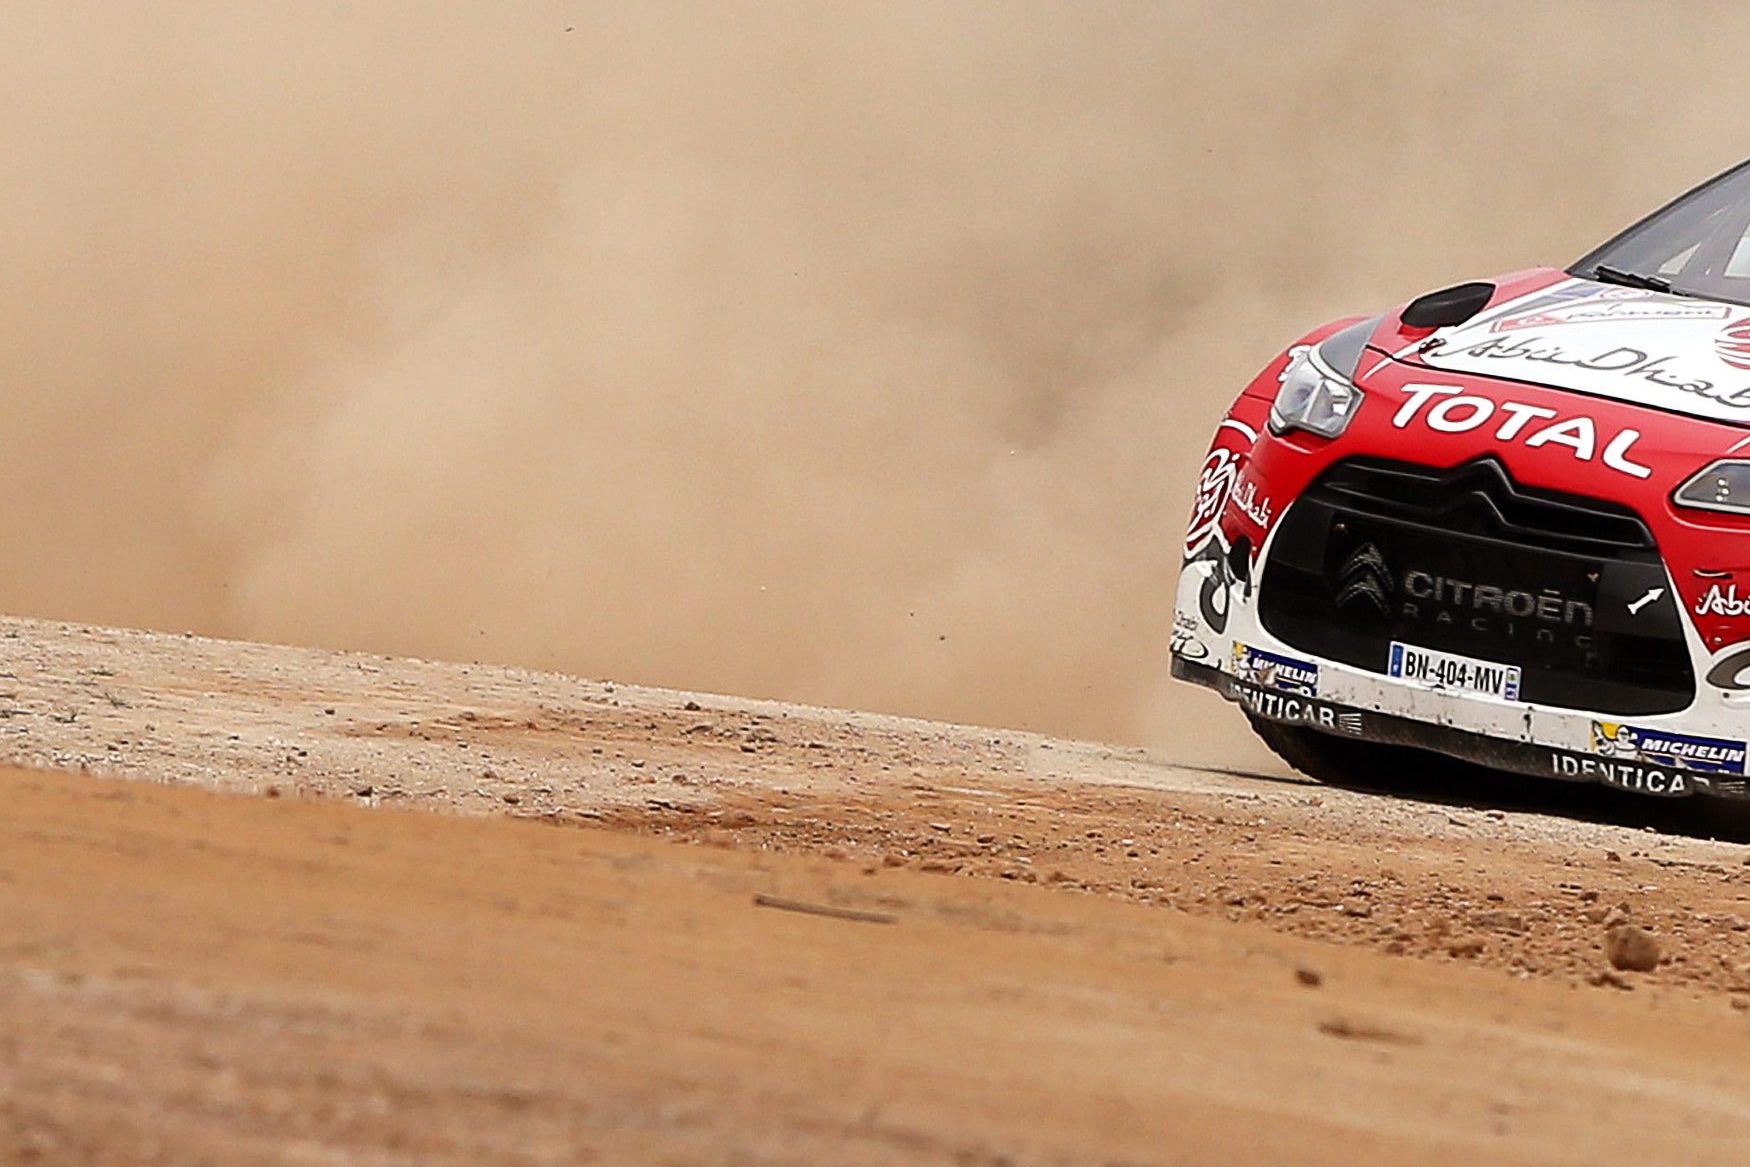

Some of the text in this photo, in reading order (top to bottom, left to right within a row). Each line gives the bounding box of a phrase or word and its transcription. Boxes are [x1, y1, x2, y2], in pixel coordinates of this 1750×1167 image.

[1392, 383, 1652, 479] TOTAL
[1404, 651, 1504, 695] BN-404-MV
[1640, 737, 1745, 763] MICHELIN
